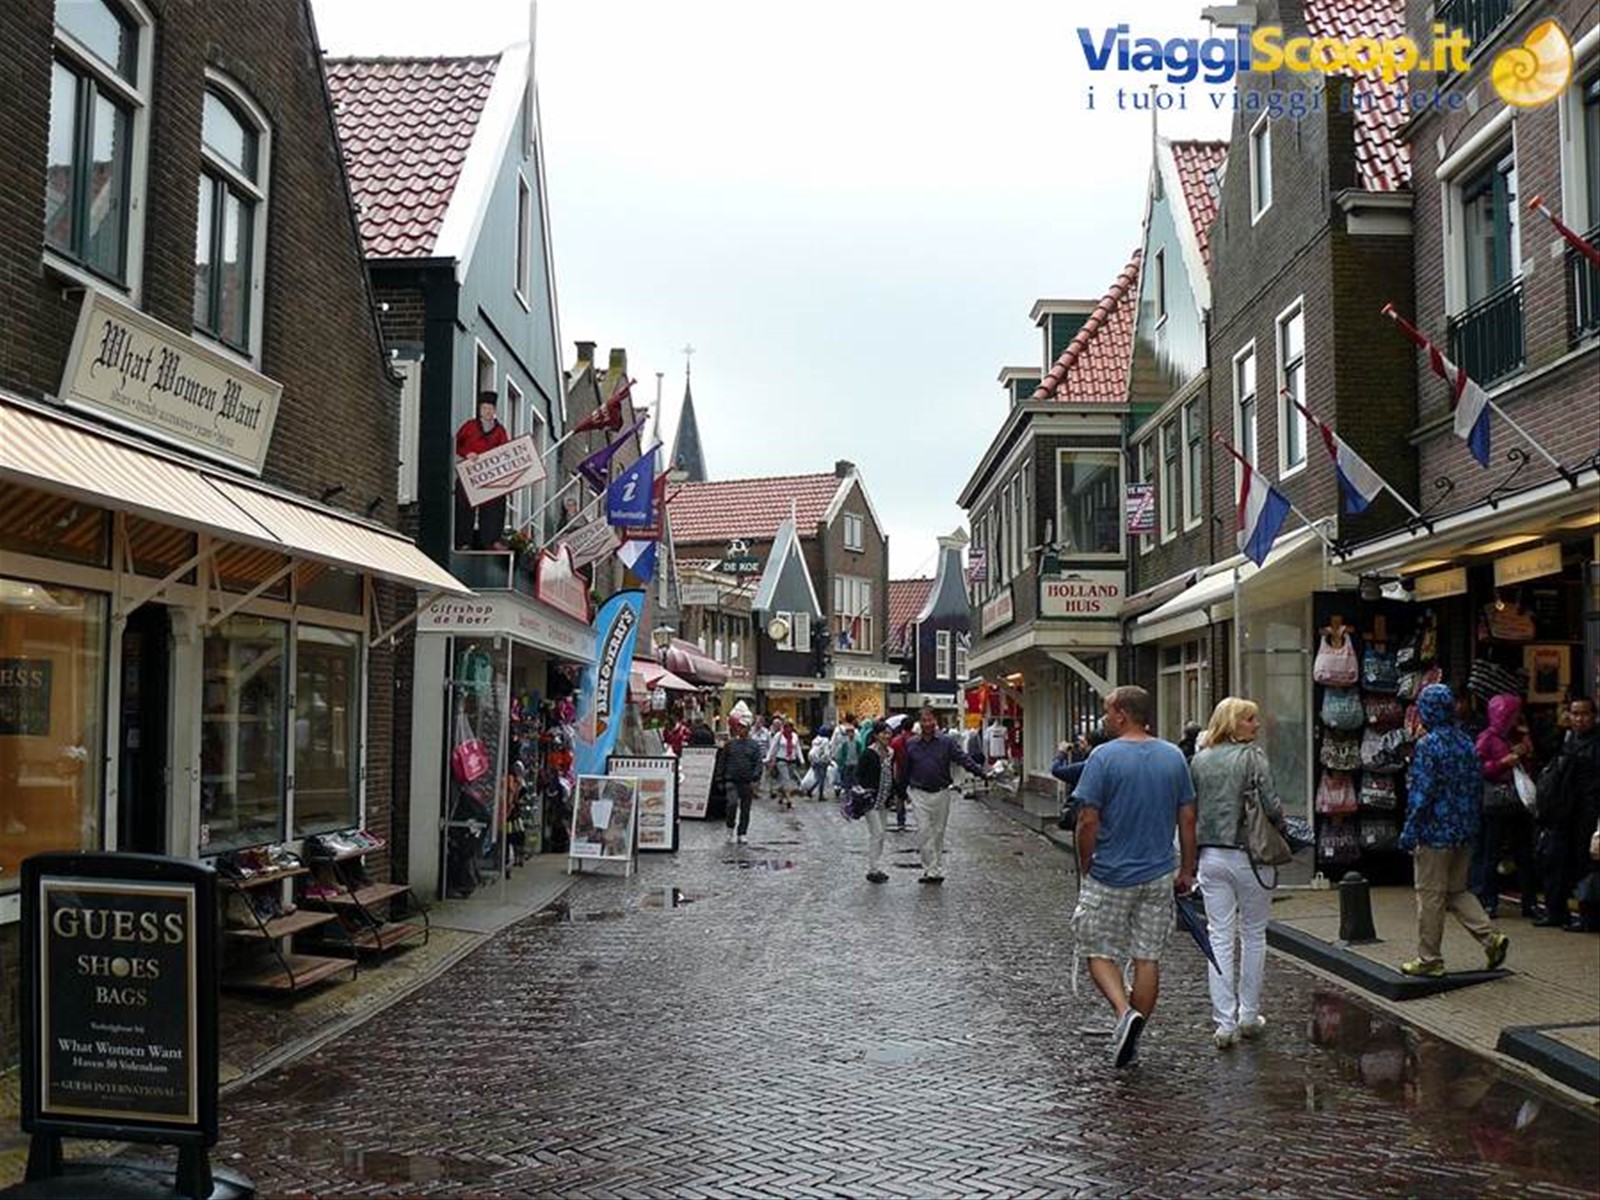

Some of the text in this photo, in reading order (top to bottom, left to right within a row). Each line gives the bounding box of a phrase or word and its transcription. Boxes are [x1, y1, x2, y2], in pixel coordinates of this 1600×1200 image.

[90, 320, 154, 390] What
[148, 347, 217, 410] Women
[214, 378, 263, 430] Want
[466, 443, 528, 475] FOTO'S IN
[469, 454, 532, 487] KOSTUUM
[723, 562, 760, 571] DE KOE
[1047, 584, 1119, 598] HOLLAND
[430, 603, 493, 614] Giftshop
[1065, 600, 1101, 613] HUIS
[433, 614, 491, 624] de Boer
[53, 907, 184, 944] GUESS
[78, 954, 160, 979] SHOES
[96, 986, 148, 1006] BAGS
[58, 1038, 183, 1059] What Women Want
[72, 1056, 104, 1068] Haven
[119, 1060, 168, 1073] Volendam
